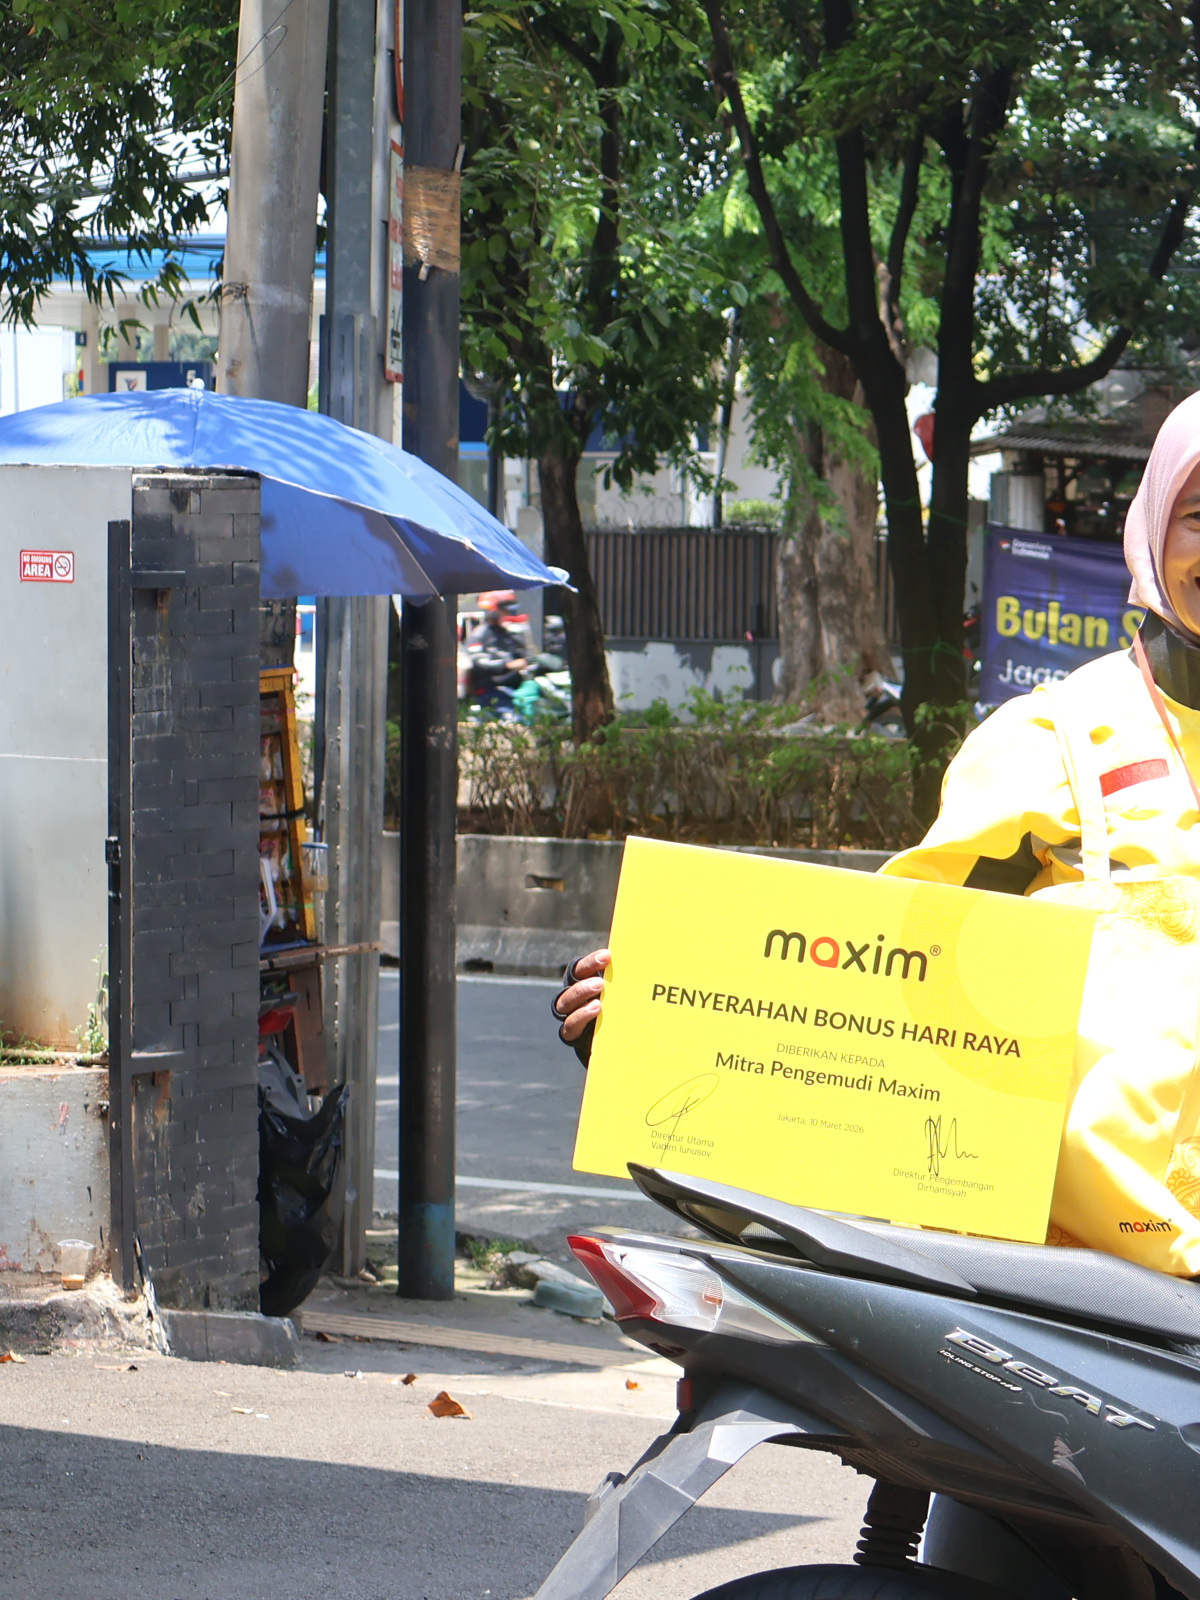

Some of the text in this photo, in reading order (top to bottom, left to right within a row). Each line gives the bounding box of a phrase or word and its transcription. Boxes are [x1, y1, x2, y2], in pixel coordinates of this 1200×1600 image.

[24, 563, 51, 578] AREA
[996, 595, 1110, 648] Bulan
[651, 983, 1022, 1058] PENYERAHAN BONUS HARI RAYA
[776, 1042, 886, 1069] DIBERIKAN KEPADA
[715, 1051, 942, 1102] Mitra Pengemudi Maxim
[777, 1113, 865, 1134] Jakarta, 10 Maret 2026
[651, 1129, 715, 1148] Direktur Utama
[651, 1141, 677, 1153] Vadim
[893, 1167, 995, 1192] Direktur Pengembangan
[917, 1182, 967, 1198] Dirhamsyah
[939, 1349, 1002, 1382] IDLING STOP
